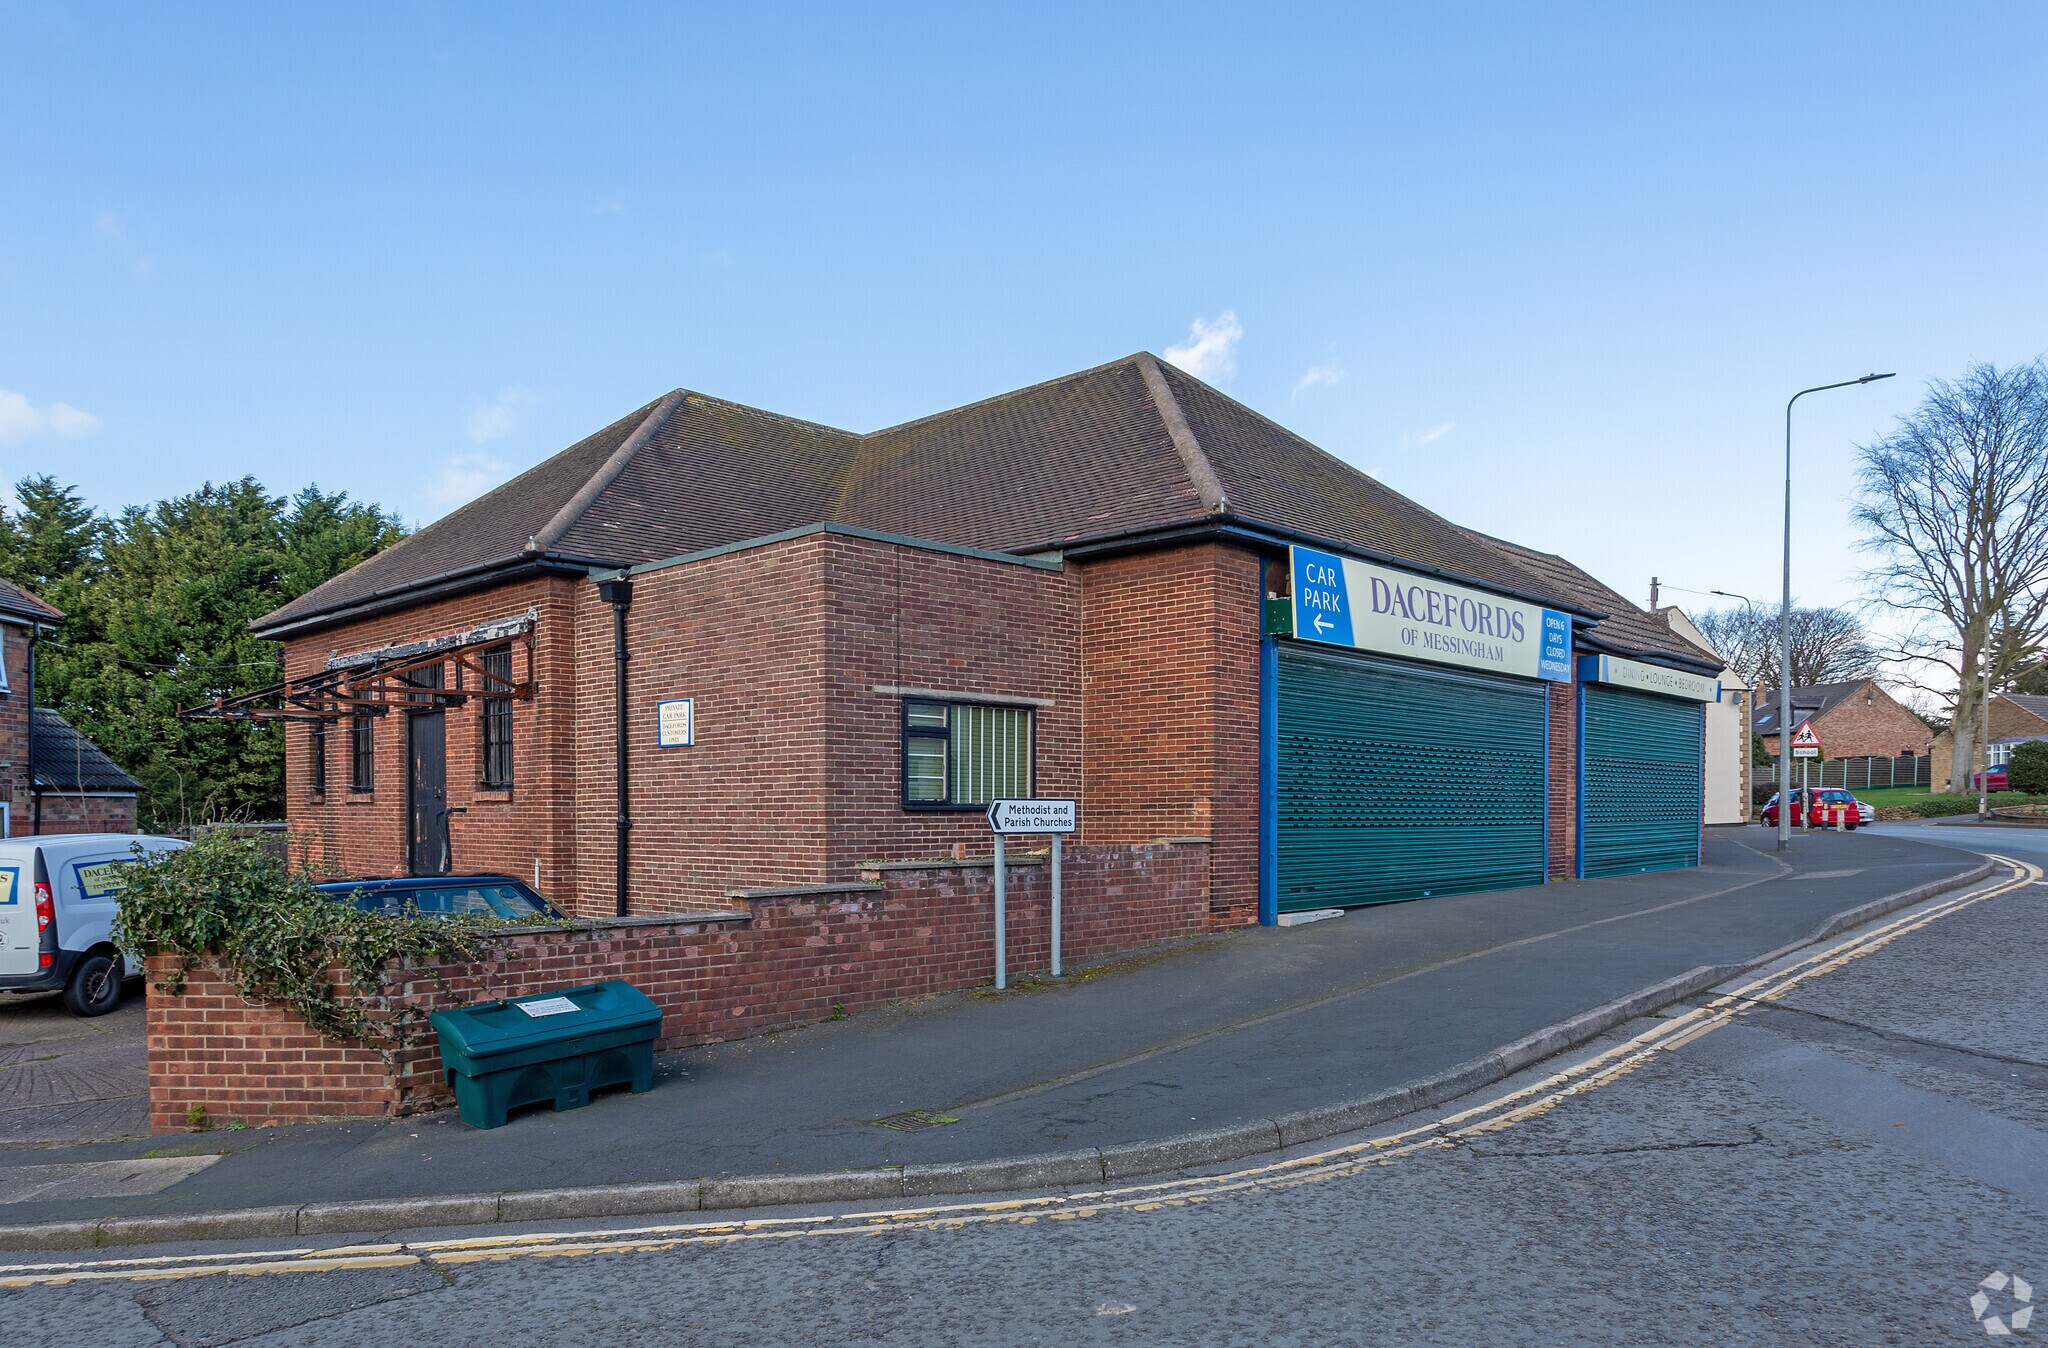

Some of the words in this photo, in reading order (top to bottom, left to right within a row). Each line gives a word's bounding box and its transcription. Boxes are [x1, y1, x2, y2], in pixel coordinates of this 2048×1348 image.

[1306, 563, 1337, 588] CAR
[1304, 587, 1341, 613] PARK
[1369, 576, 1525, 643] DACEFORDS
[1546, 617, 1560, 630] OPEN
[1560, 621, 1565, 631] 6
[1401, 627, 1419, 646] OF
[1423, 631, 1504, 662] MESSINGHAM
[1549, 632, 1563, 645] DAYS
[1546, 646, 1566, 659] CLOSED
[1540, 659, 1571, 673] WEDNESDAY
[1622, 666, 1645, 682] DINING
[1650, 672, 1673, 688] LOUNGE
[1678, 678, 1705, 694] BEDROOM
[1008, 804, 1051, 815] Methodist
[1053, 805, 1069, 815] and
[1004, 817, 1031, 827] Parish
[1033, 817, 1072, 827] Churches
